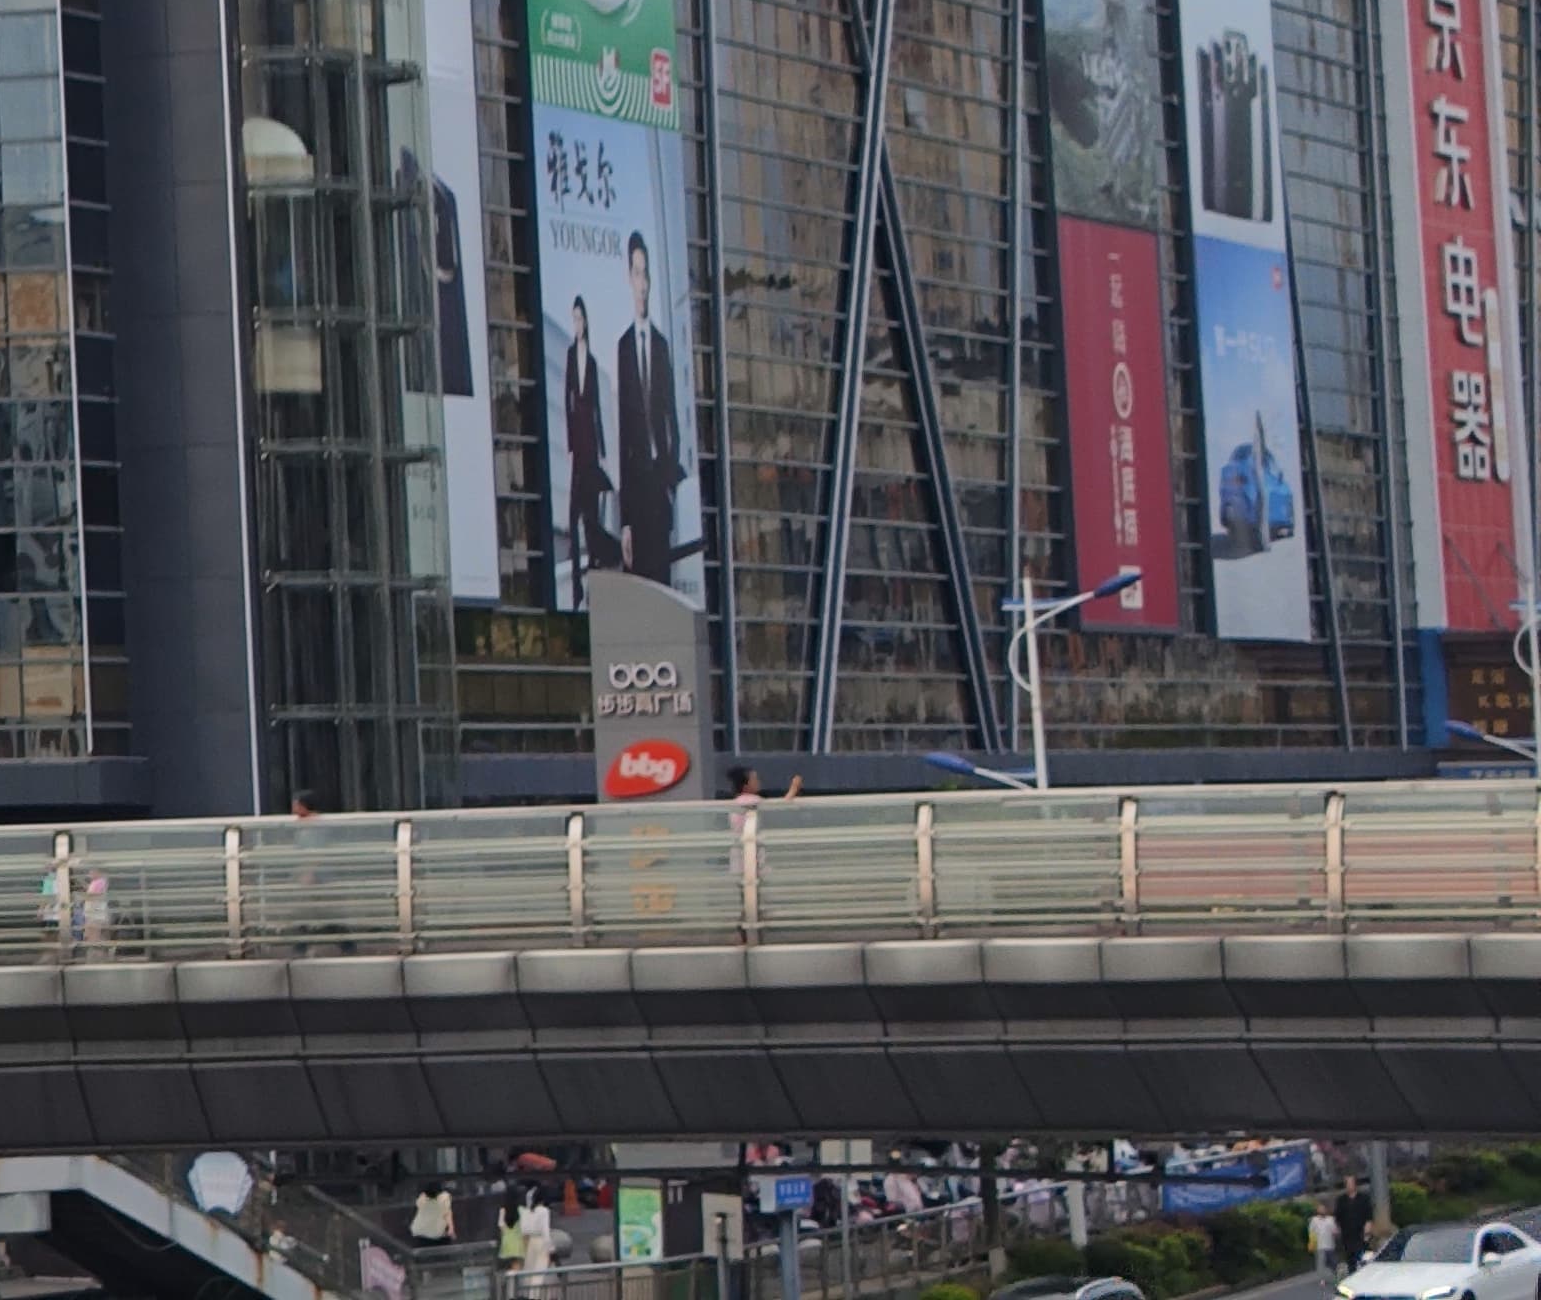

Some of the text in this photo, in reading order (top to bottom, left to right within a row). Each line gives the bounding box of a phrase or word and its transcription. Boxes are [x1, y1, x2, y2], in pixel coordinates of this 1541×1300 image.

[549, 218, 623, 260] YOUNGOR
[597, 690, 693, 717] 步步高广场
[619, 751, 676, 787] bbg
